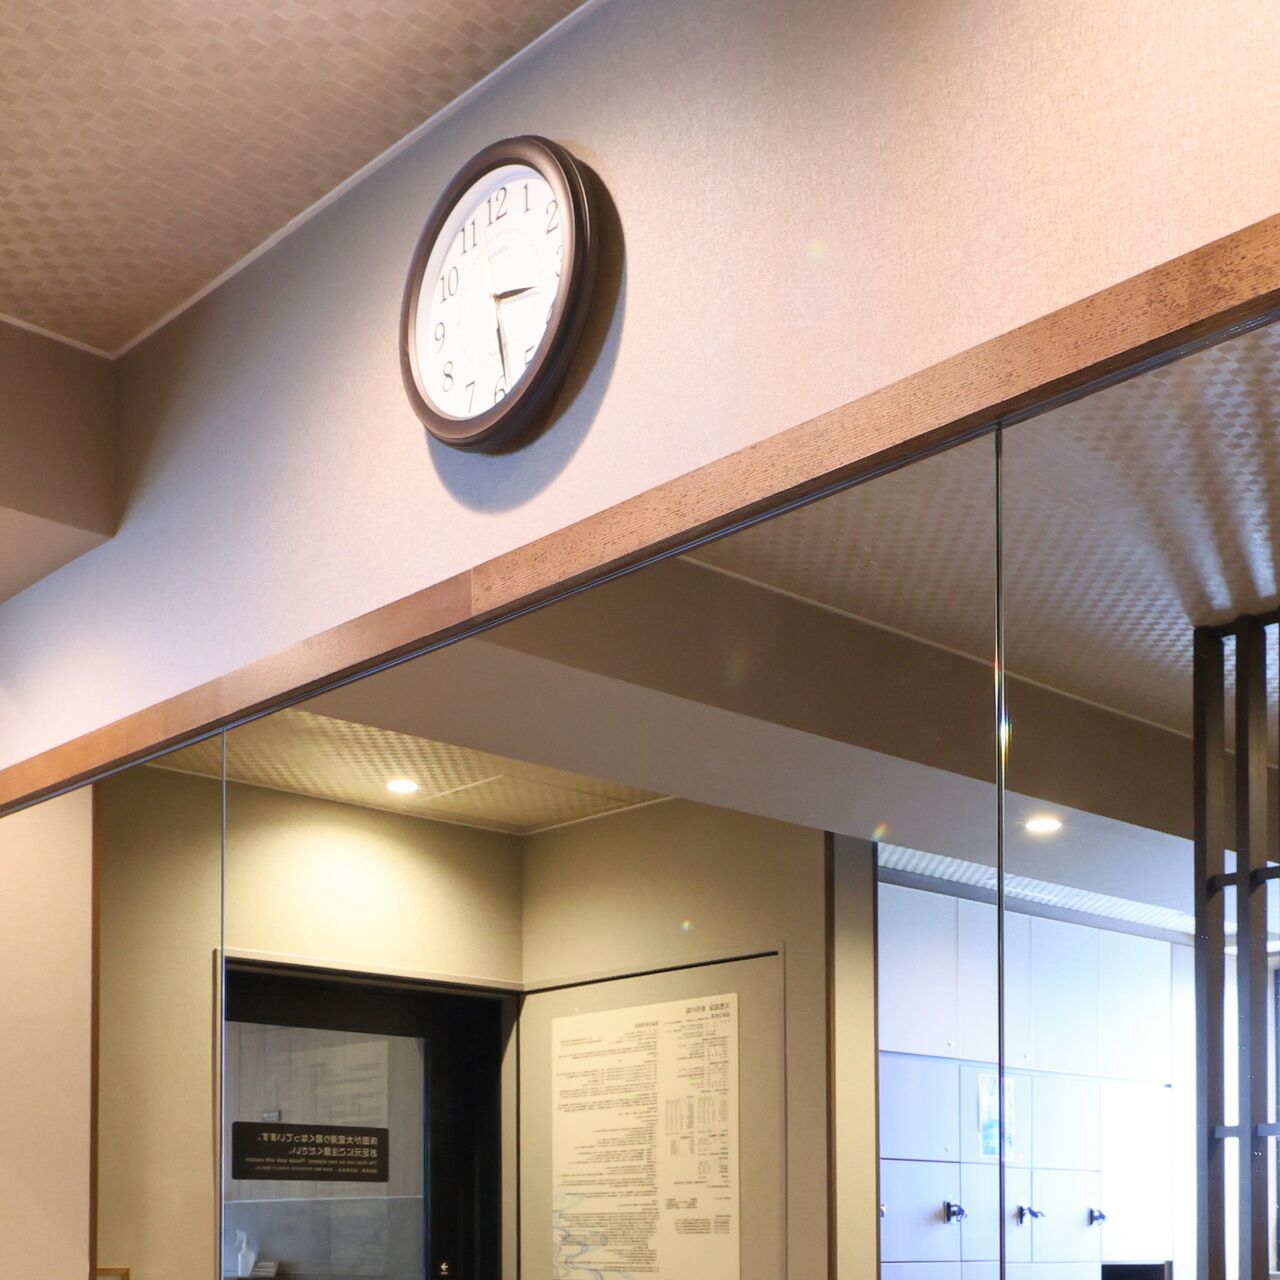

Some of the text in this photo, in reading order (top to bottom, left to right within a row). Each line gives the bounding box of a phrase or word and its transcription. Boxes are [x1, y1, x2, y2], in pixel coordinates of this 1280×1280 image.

[486, 187, 507, 227] 12
[523, 183, 531, 214] 1
[546, 199, 559, 234] 2
[461, 221, 478, 255] 11
[441, 266, 459, 303] 10
[434, 321, 446, 354] 9
[442, 361, 453, 392] 8
[494, 375, 507, 405] 6
[465, 381, 475, 414] 7
